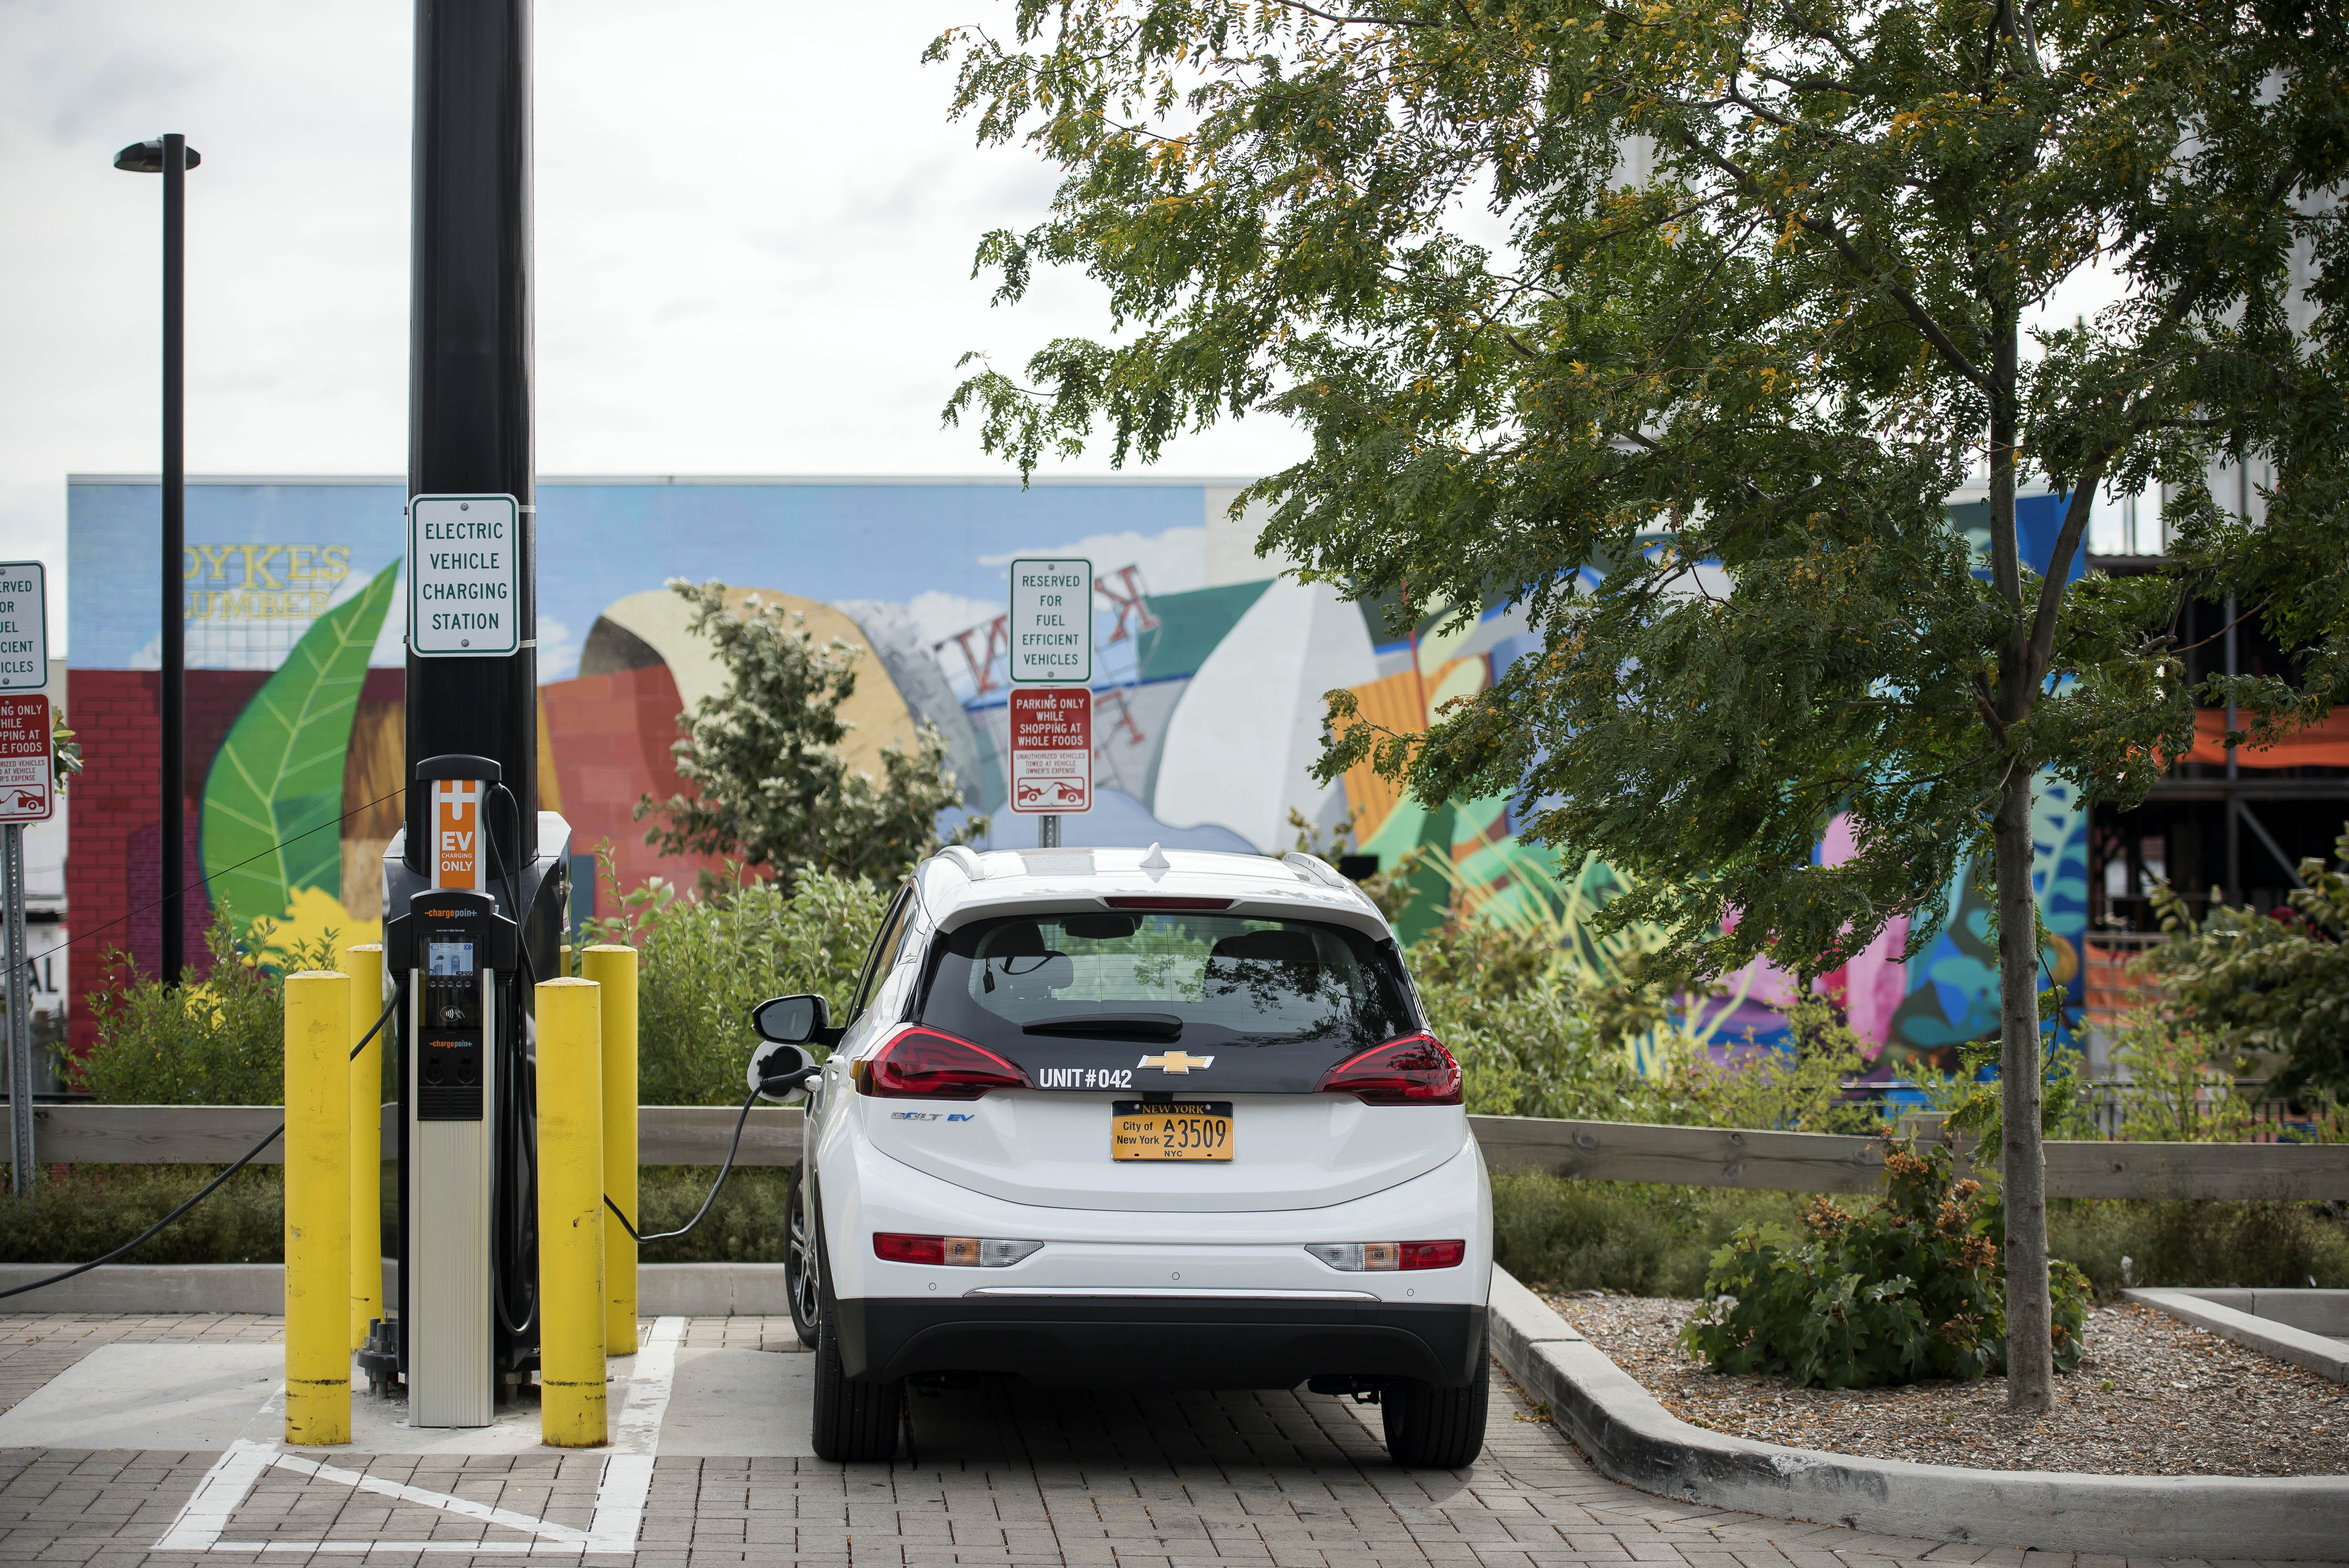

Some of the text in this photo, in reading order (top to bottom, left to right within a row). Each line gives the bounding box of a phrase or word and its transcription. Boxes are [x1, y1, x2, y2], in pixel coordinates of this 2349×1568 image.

[425, 523, 503, 539] ELECTRIC
[430, 553, 500, 569] VEHICLE
[1022, 575, 1080, 587] RESERVED
[423, 583, 507, 599] CHARGING
[0, 601, 15, 613] OR
[184, 590, 330, 620] UMBER
[1040, 595, 1061, 607] FOR
[432, 613, 499, 630] STATION
[1036, 615, 1065, 626] FUEL
[1022, 633, 1079, 645] EFFICIENT
[0, 641, 33, 653] CIENT
[1024, 653, 1078, 665] VEHICLES
[0, 661, 33, 673] ICLES
[17, 704, 42, 715] ONLY
[1016, 698, 1084, 710] PARKING ONLY
[1036, 710, 1064, 722] WHILE
[1019, 722, 1082, 734] SHOPPING AT
[29, 730, 40, 740] AT
[1017, 735, 1083, 747] WHOLE FOODS
[11, 742, 42, 753] FOODS
[442, 831, 473, 851] EV
[441, 860, 473, 871] ONLY
[1142, 1105, 1204, 1114] NEW YORK
[891, 1111, 975, 1122] BOLT EV
[1123, 1121, 1154, 1132] City of
[1116, 1135, 1159, 1144] New York
